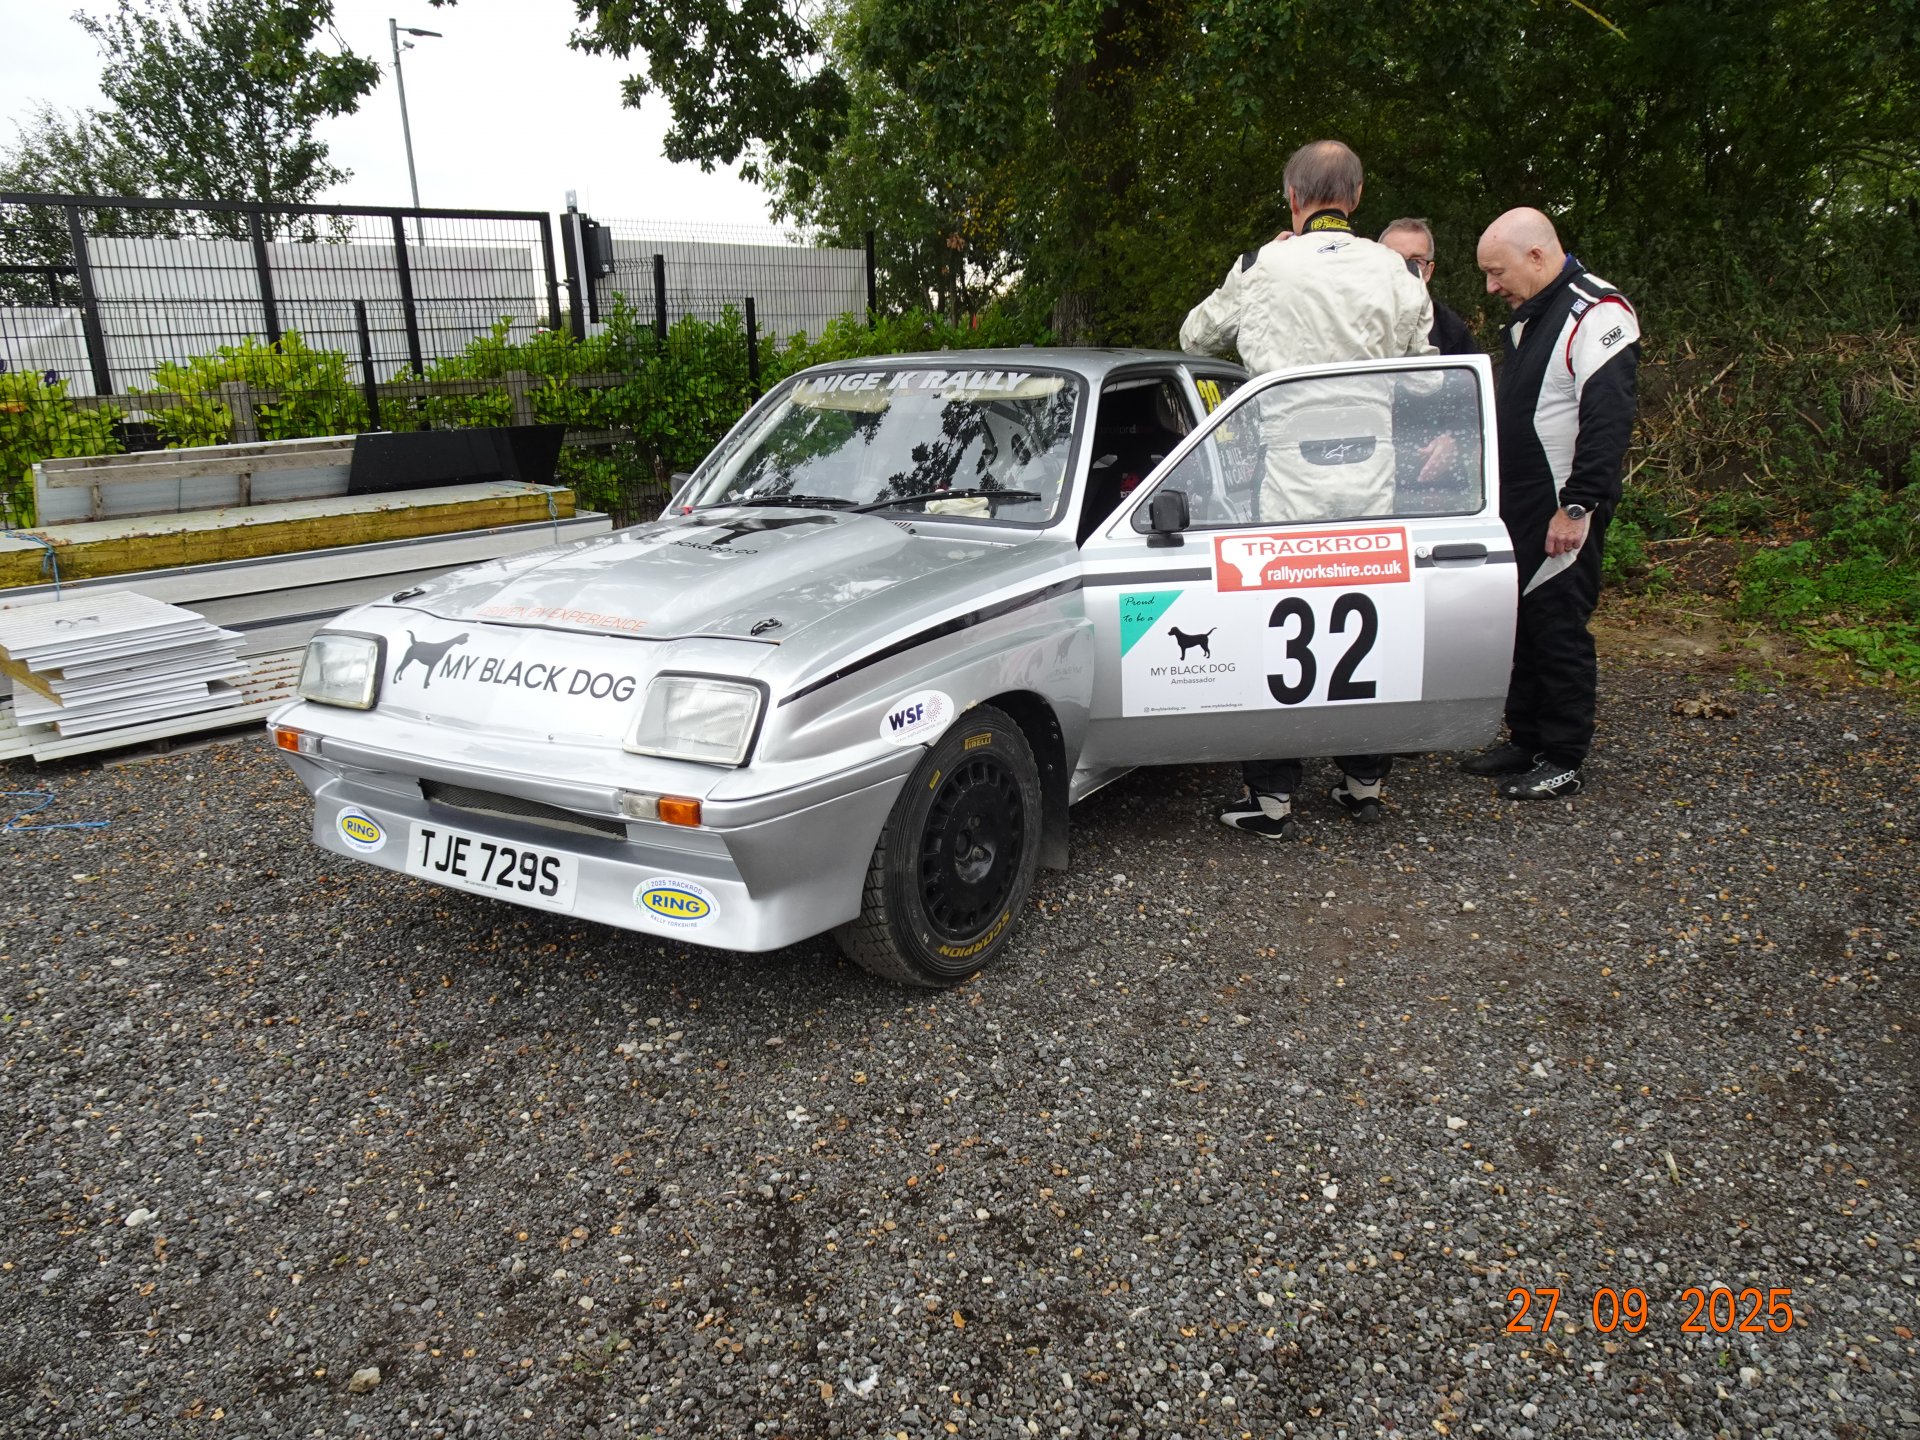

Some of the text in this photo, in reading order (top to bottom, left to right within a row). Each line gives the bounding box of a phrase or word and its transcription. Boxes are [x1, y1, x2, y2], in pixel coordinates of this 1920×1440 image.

[1602, 328, 1622, 346] OMP
[807, 370, 1031, 394] NIGE K RALLY
[1242, 535, 1392, 556] TRACKROD
[1267, 560, 1402, 583] rallyyorkshire.co.uk
[1124, 596, 1155, 606] Proud
[548, 608, 649, 632] EXPERIENCE
[1123, 614, 1133, 623] to
[1136, 612, 1145, 622] be
[1267, 592, 1378, 705] 32
[439, 653, 637, 702] MY BLACK DOG
[1150, 662, 1236, 677] MY BLACK DOG
[1171, 676, 1216, 685] Ambassador
[888, 702, 924, 731] WSF
[964, 732, 992, 750] PIRELLI
[1540, 769, 1576, 789] sparco
[347, 820, 375, 838] RING
[421, 829, 560, 897] TJE 729S
[650, 879, 703, 895] 2025 TRACKROD
[652, 893, 701, 913] RING
[650, 913, 667, 925] RALLY
[936, 910, 1011, 958] SCORPION
